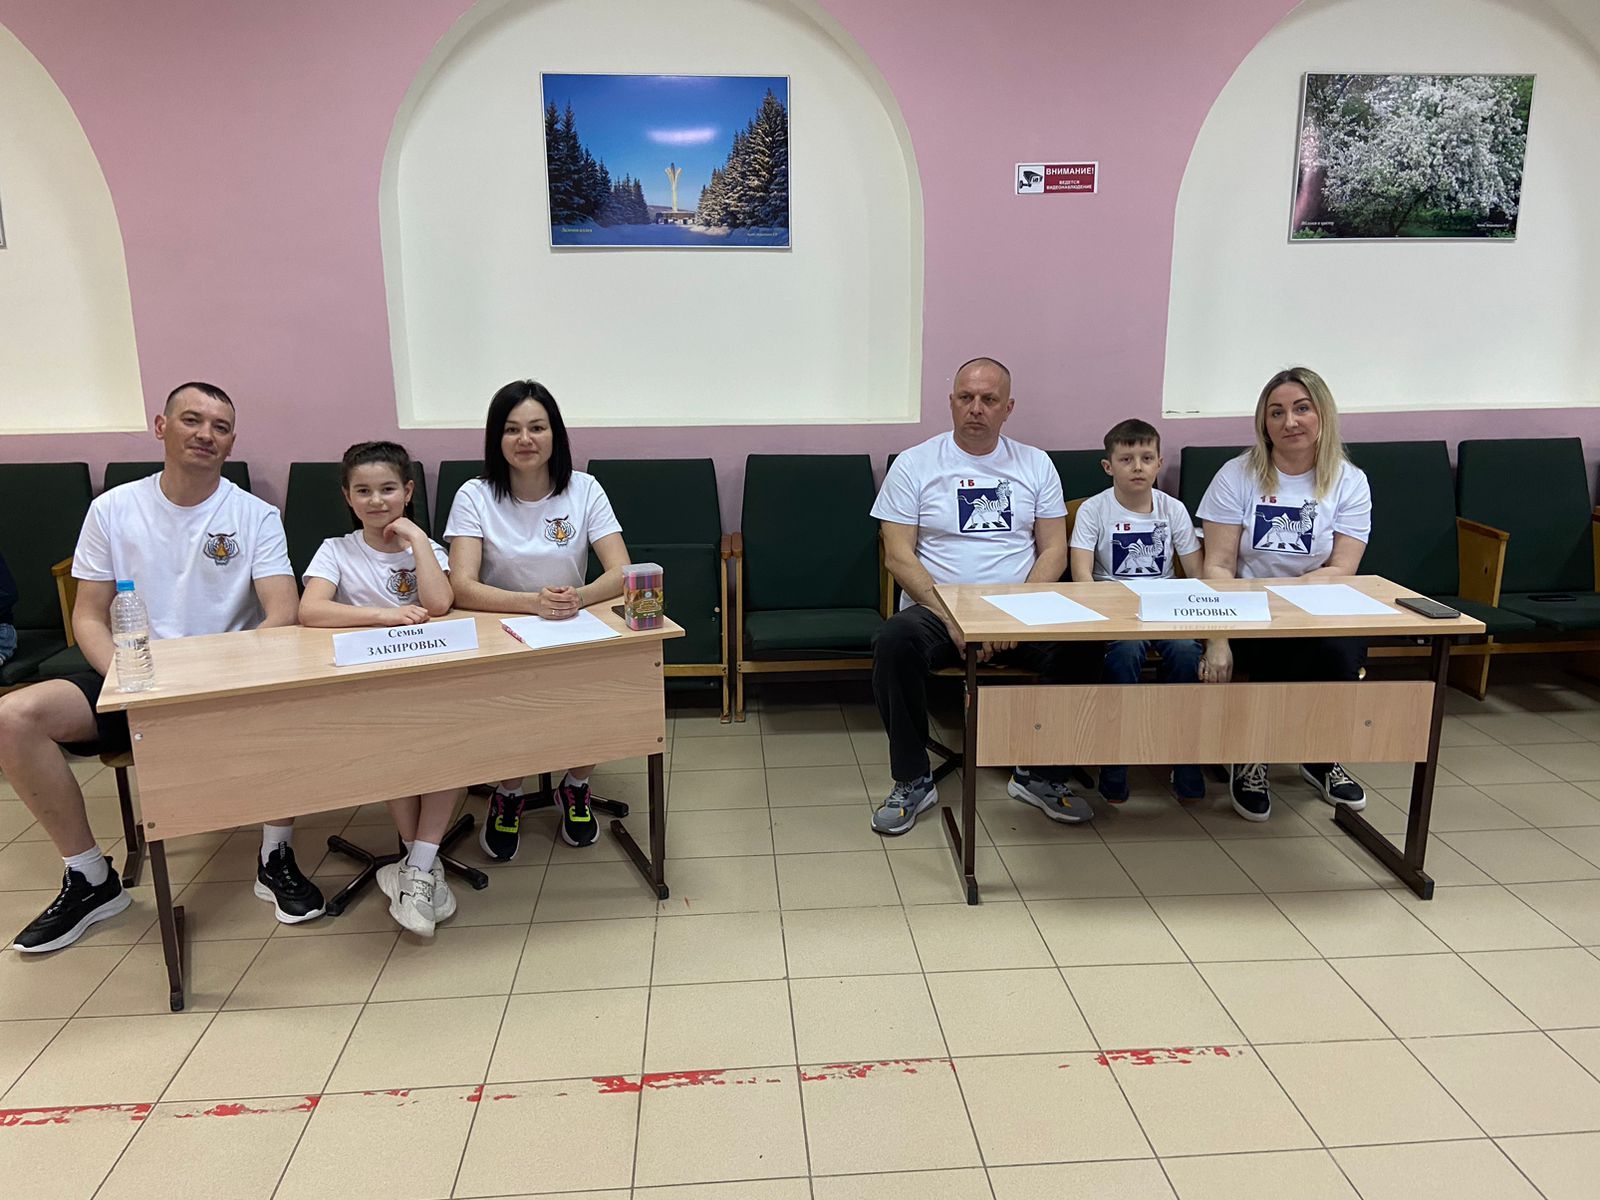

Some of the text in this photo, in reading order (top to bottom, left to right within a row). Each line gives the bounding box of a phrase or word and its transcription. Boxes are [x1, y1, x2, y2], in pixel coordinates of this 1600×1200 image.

[1046, 167, 1094, 175] ВНИМАНИЕ!
[960, 479, 975, 487] 1 Б
[1261, 495, 1266, 503] 1
[1115, 523, 1131, 531] 1 Б
[1188, 594, 1220, 603] Семья
[1173, 608, 1238, 617] ГОРБОВЫХ
[388, 628, 424, 638] Семья
[367, 638, 448, 656] ЗАКИРОВЫХ
